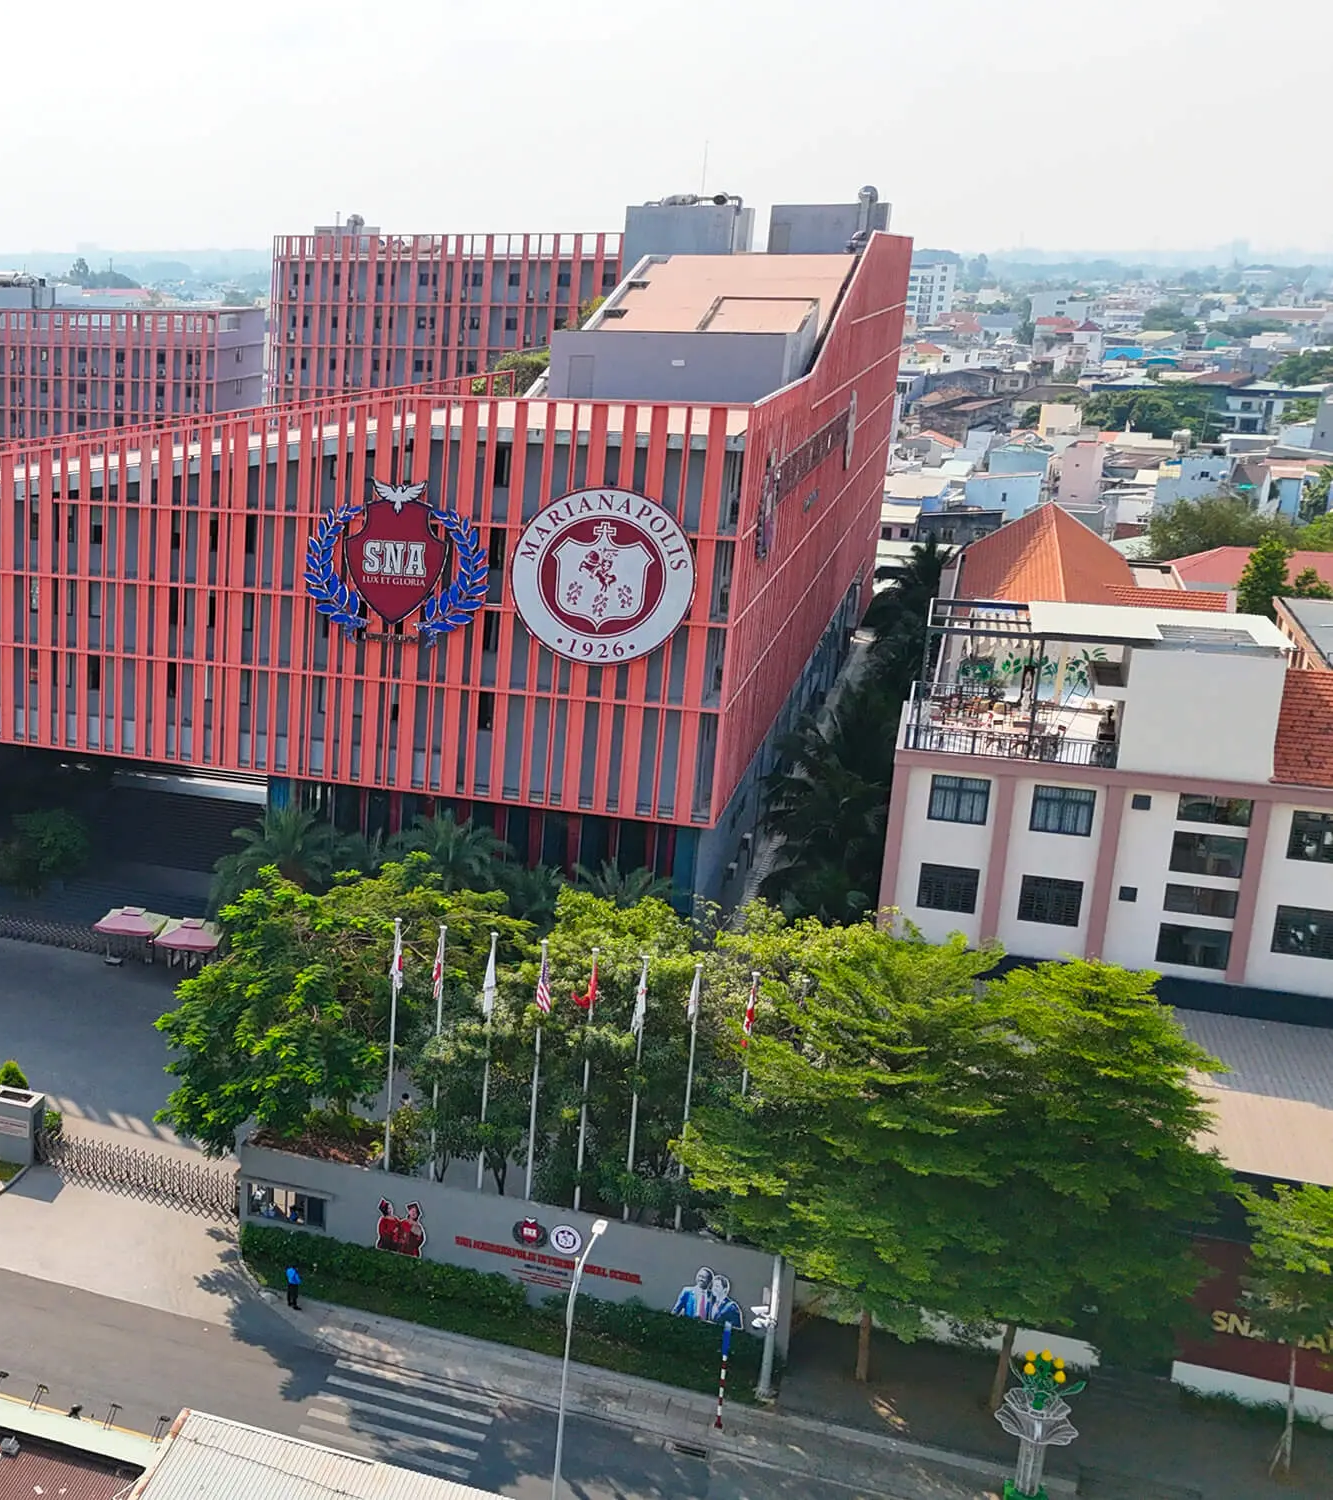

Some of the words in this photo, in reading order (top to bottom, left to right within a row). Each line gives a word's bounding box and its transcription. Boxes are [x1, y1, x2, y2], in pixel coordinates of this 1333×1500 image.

[520, 494, 688, 572] MARIANAPOLIS
[362, 539, 426, 578] SNA
[362, 575, 379, 584] LUX
[380, 577, 391, 585] ET
[392, 578, 426, 587] GLORIA
[568, 638, 625, 658] 1926
